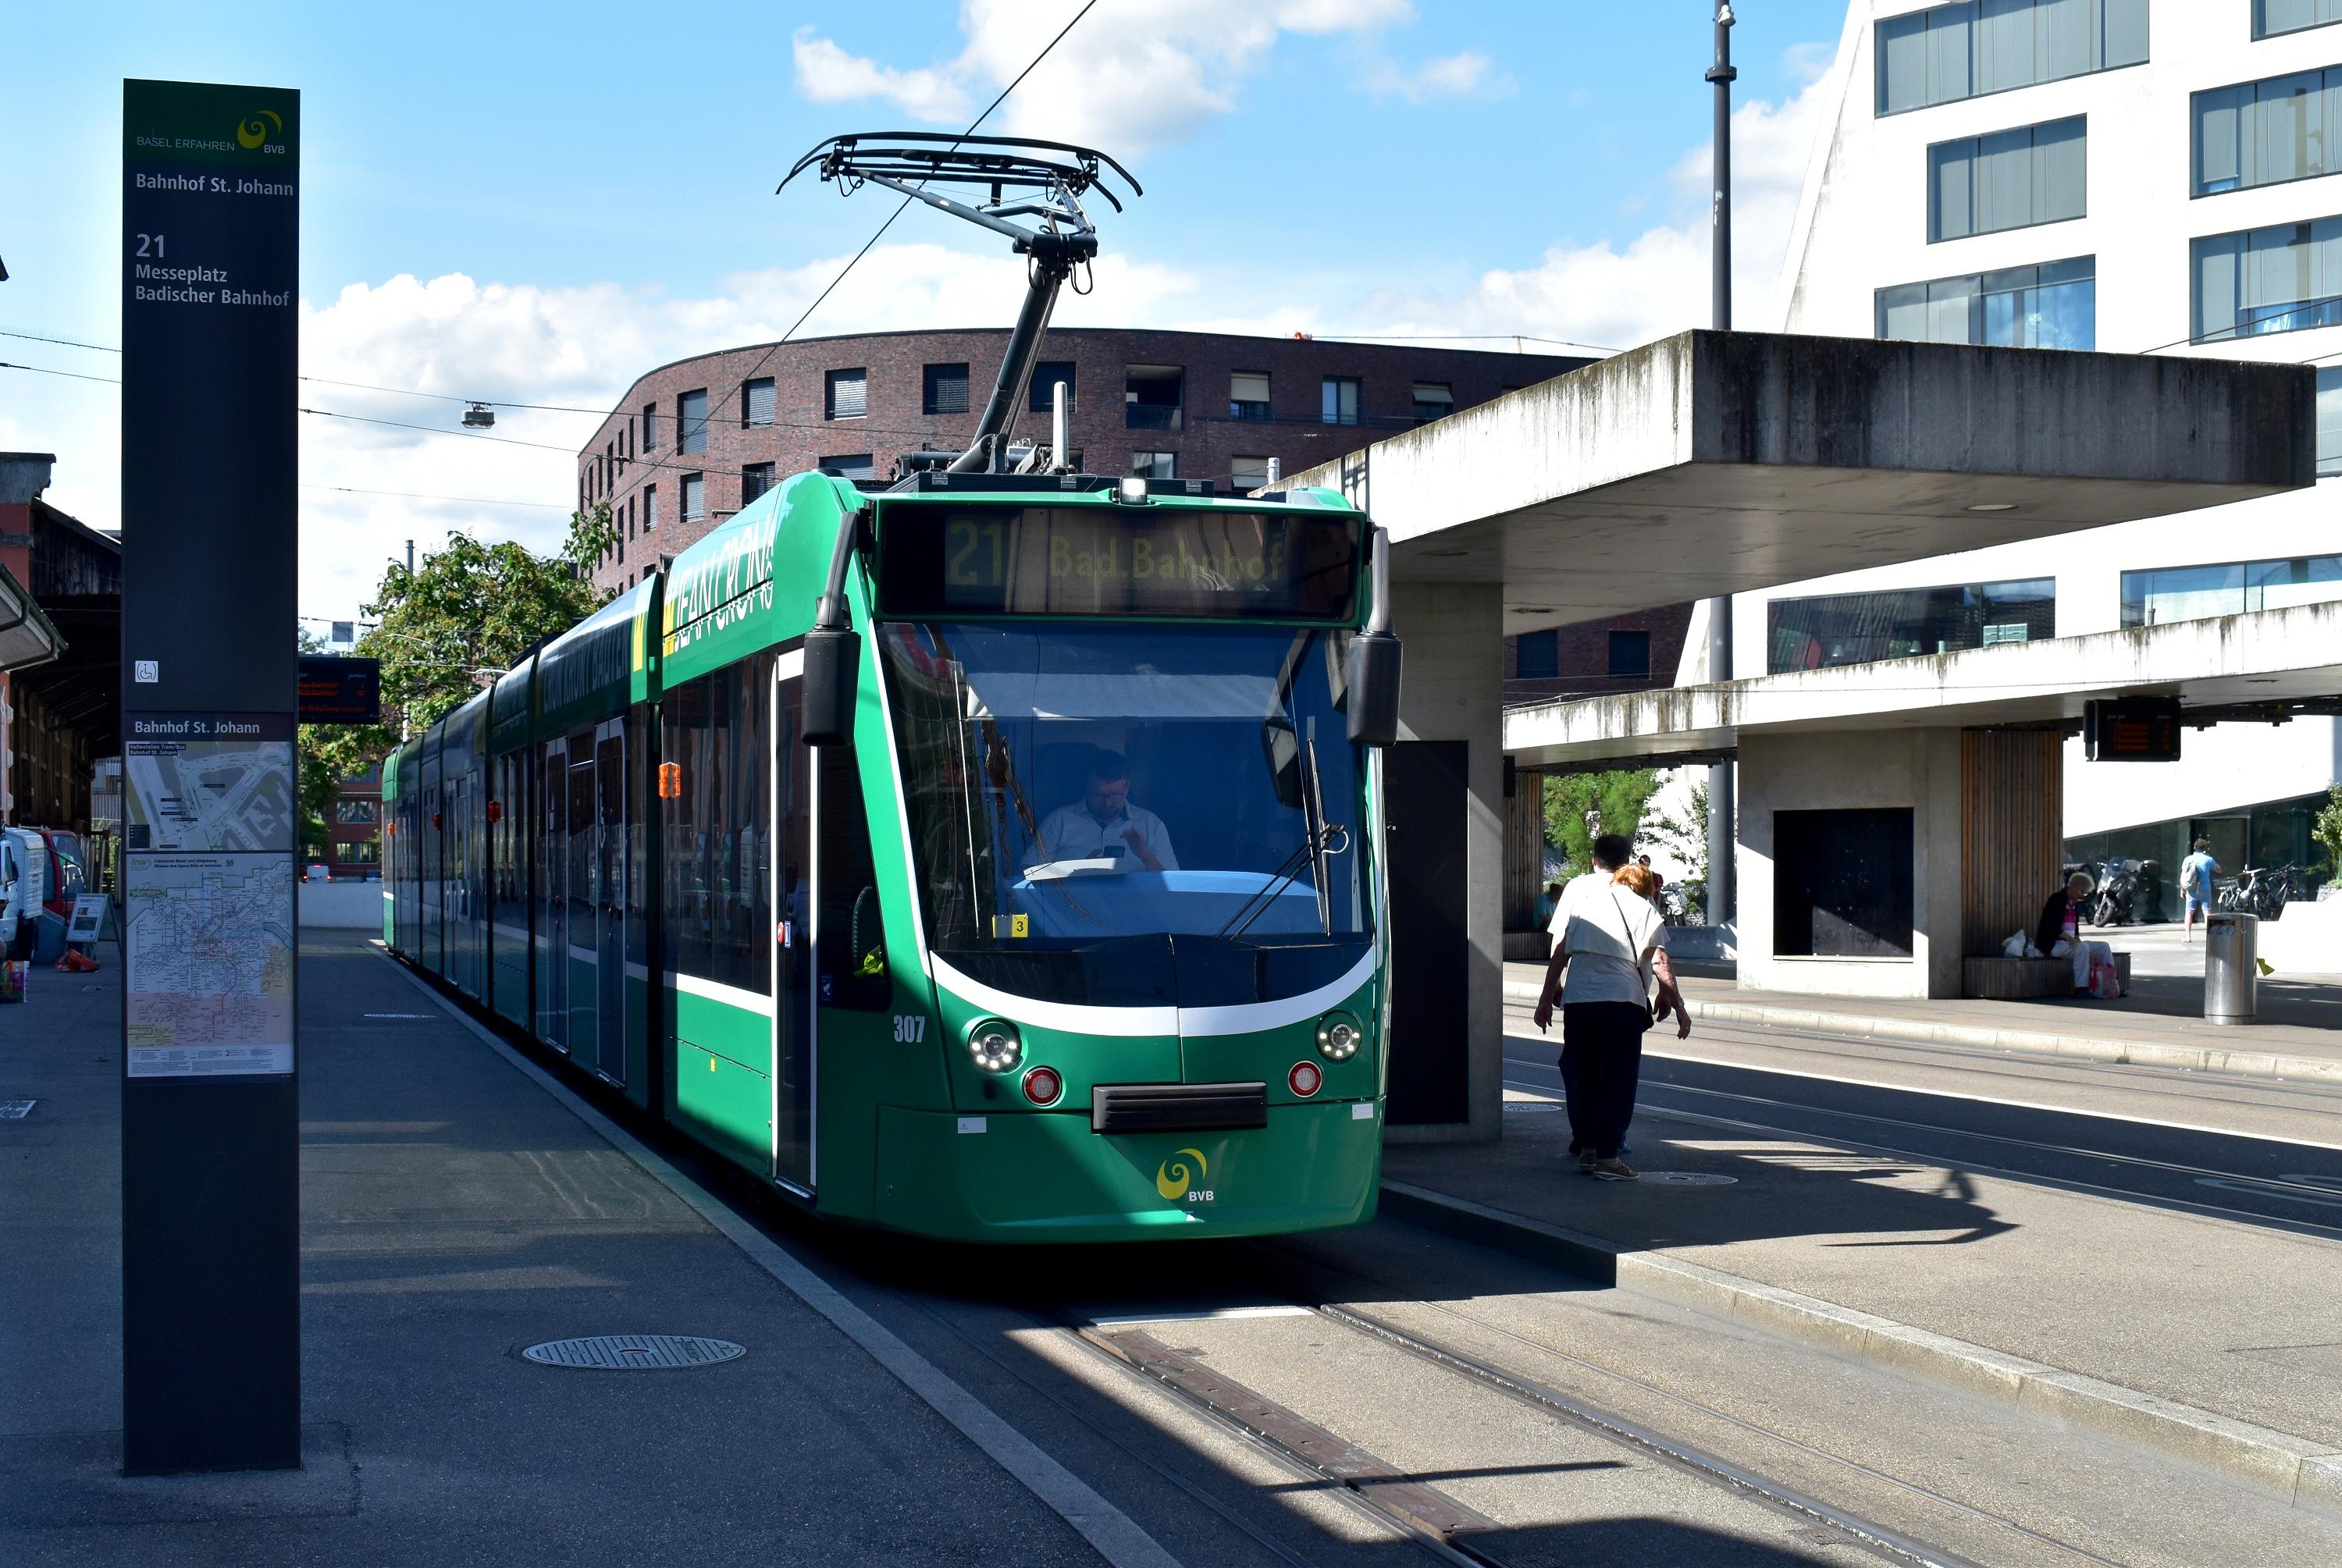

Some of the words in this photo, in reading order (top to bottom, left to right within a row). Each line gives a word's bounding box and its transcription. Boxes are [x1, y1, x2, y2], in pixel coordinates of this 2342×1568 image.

[137, 137, 173, 148] BASEL
[176, 139, 235, 151] ERFAHREN
[264, 144, 286, 155] BVB
[136, 173, 205, 191] Bahnhof
[211, 177, 231, 193] St.
[236, 179, 294, 196] Johann
[136, 233, 165, 258] 21
[136, 264, 228, 285] Messeplatz
[136, 285, 215, 304] Badischer
[222, 289, 290, 307] Bahnhof
[949, 521, 1002, 586] 21
[135, 720, 190, 734] Bahnhof
[193, 721, 210, 734] St.
[215, 721, 260, 734] Johann
[1016, 920, 1024, 933] 3
[893, 1015, 925, 1044] 307
[1188, 1190, 1214, 1202] BVB
